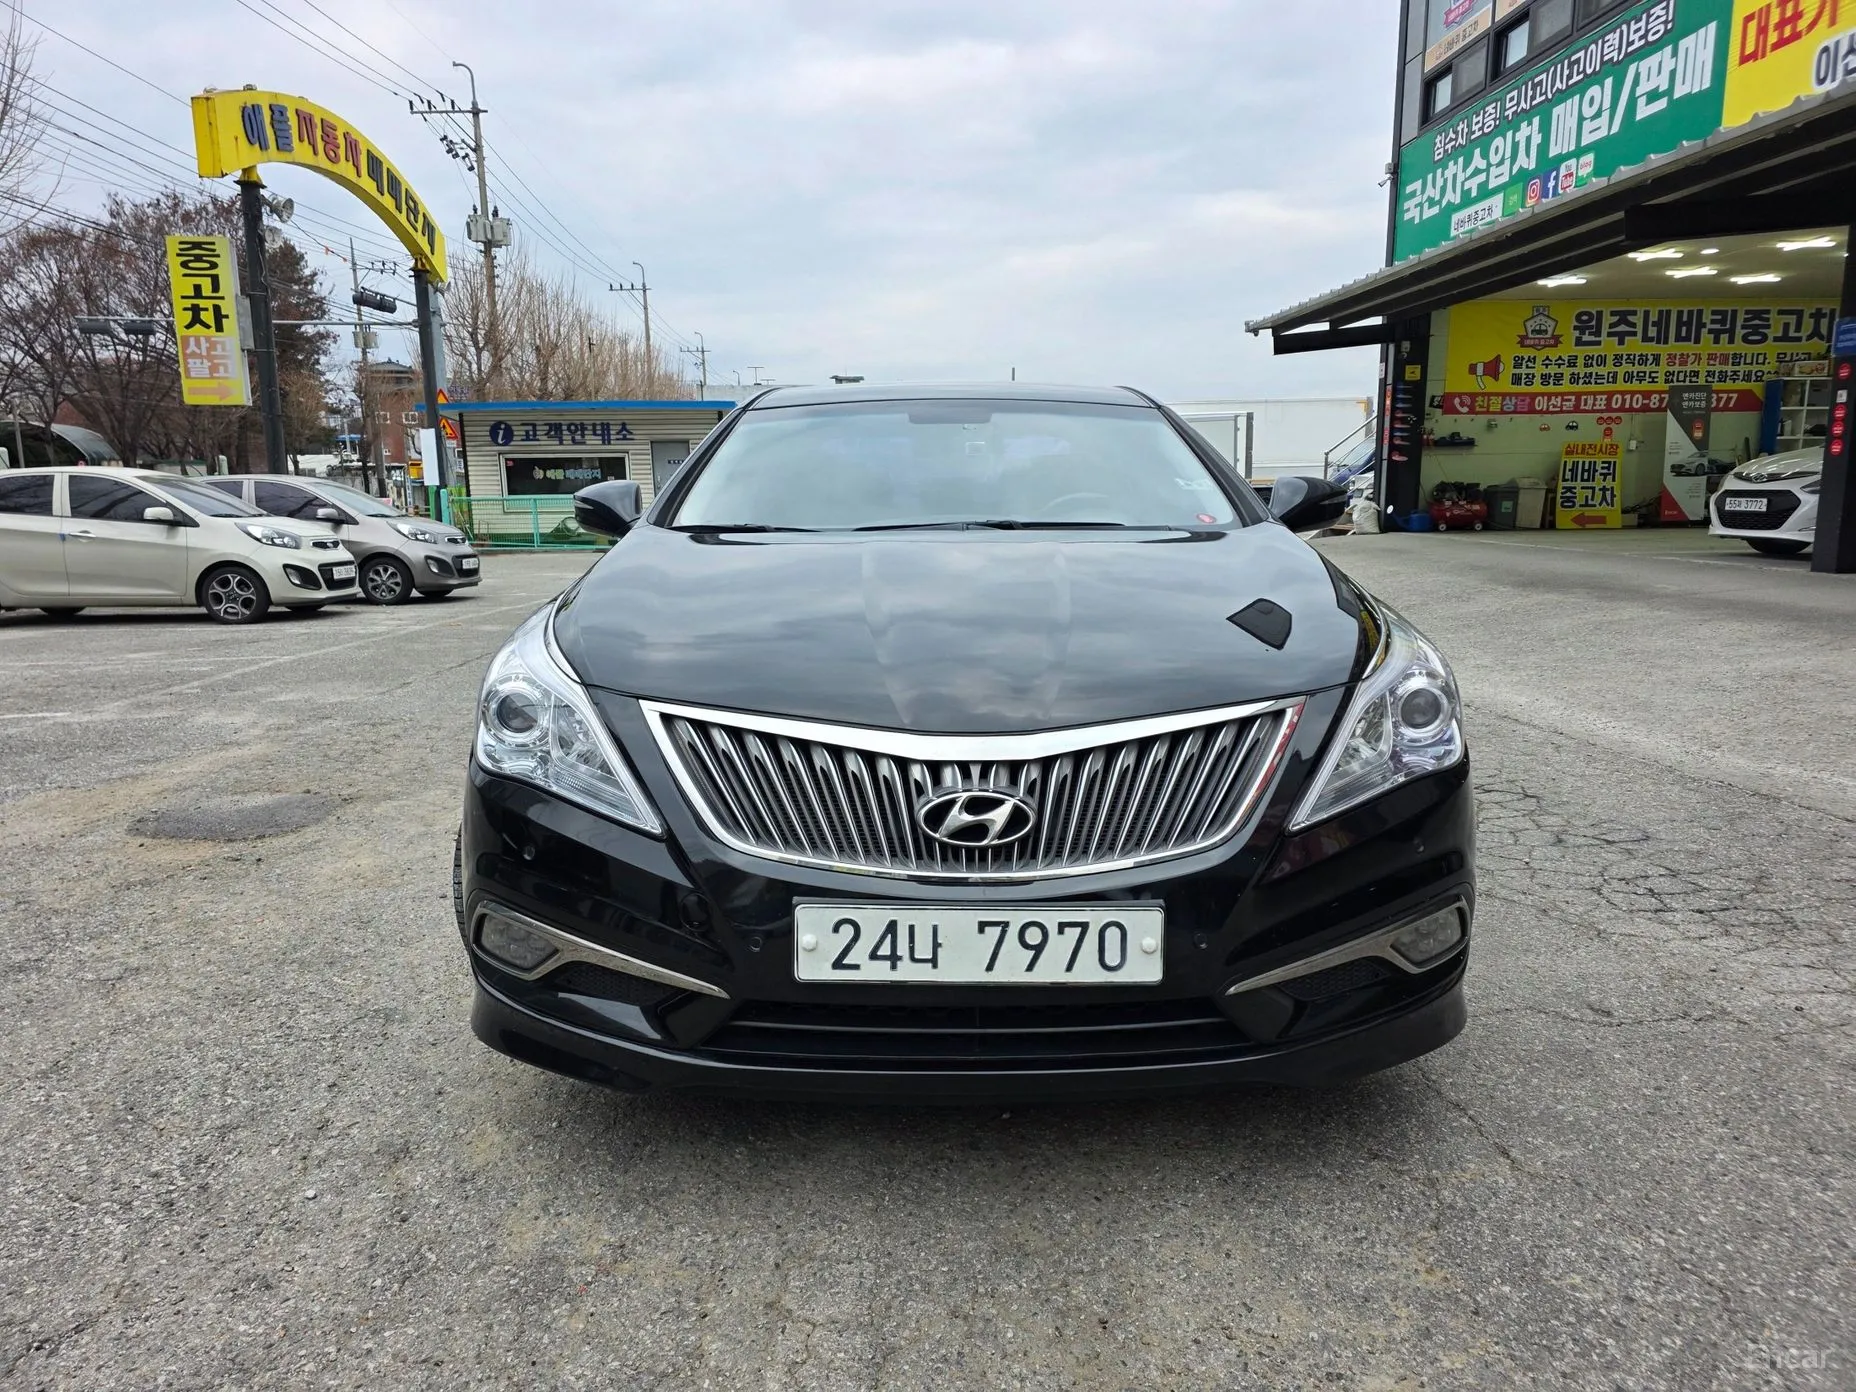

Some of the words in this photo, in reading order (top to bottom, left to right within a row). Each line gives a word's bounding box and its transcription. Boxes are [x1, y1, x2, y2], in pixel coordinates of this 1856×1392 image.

[1433, 118, 1468, 162] 침수차
[1470, 100, 1501, 141] 보증!
[1503, 0, 1677, 122] 무사고(사고이력)보증!
[1403, 115, 1543, 225] 국산차수입차
[1548, 20, 1719, 158] 매입/판매
[1453, 203, 1494, 233] 네바퀴중고차
[176, 240, 230, 333] 중고차
[1573, 308, 1836, 347] 원주네바퀴중고차
[1513, 355, 1537, 369] 알선
[1541, 354, 1578, 369] 수수료
[1583, 354, 1607, 368] 없이
[1612, 352, 1661, 368] 정직하게
[1666, 352, 1703, 367] 정찰가
[1706, 351, 1771, 367] 판매합니다.
[1511, 372, 1536, 386] 매장
[1540, 371, 1564, 386] 방문
[1568, 371, 1618, 386] 하셨는데
[1622, 370, 1660, 384] 아무도
[1664, 369, 1700, 384] 없다면
[1475, 396, 1530, 412] 친절상담
[1534, 396, 1576, 411] 이선균
[1580, 395, 1608, 410] 대표
[520, 422, 636, 445] 고객안내소
[1565, 444, 1619, 456] 실내전시장
[1563, 460, 1617, 483] 네바퀴
[1559, 485, 1617, 509] 중고차
[1744, 500, 1763, 509] 3772
[831, 917, 943, 972] 24나
[977, 920, 1128, 972] 7970
